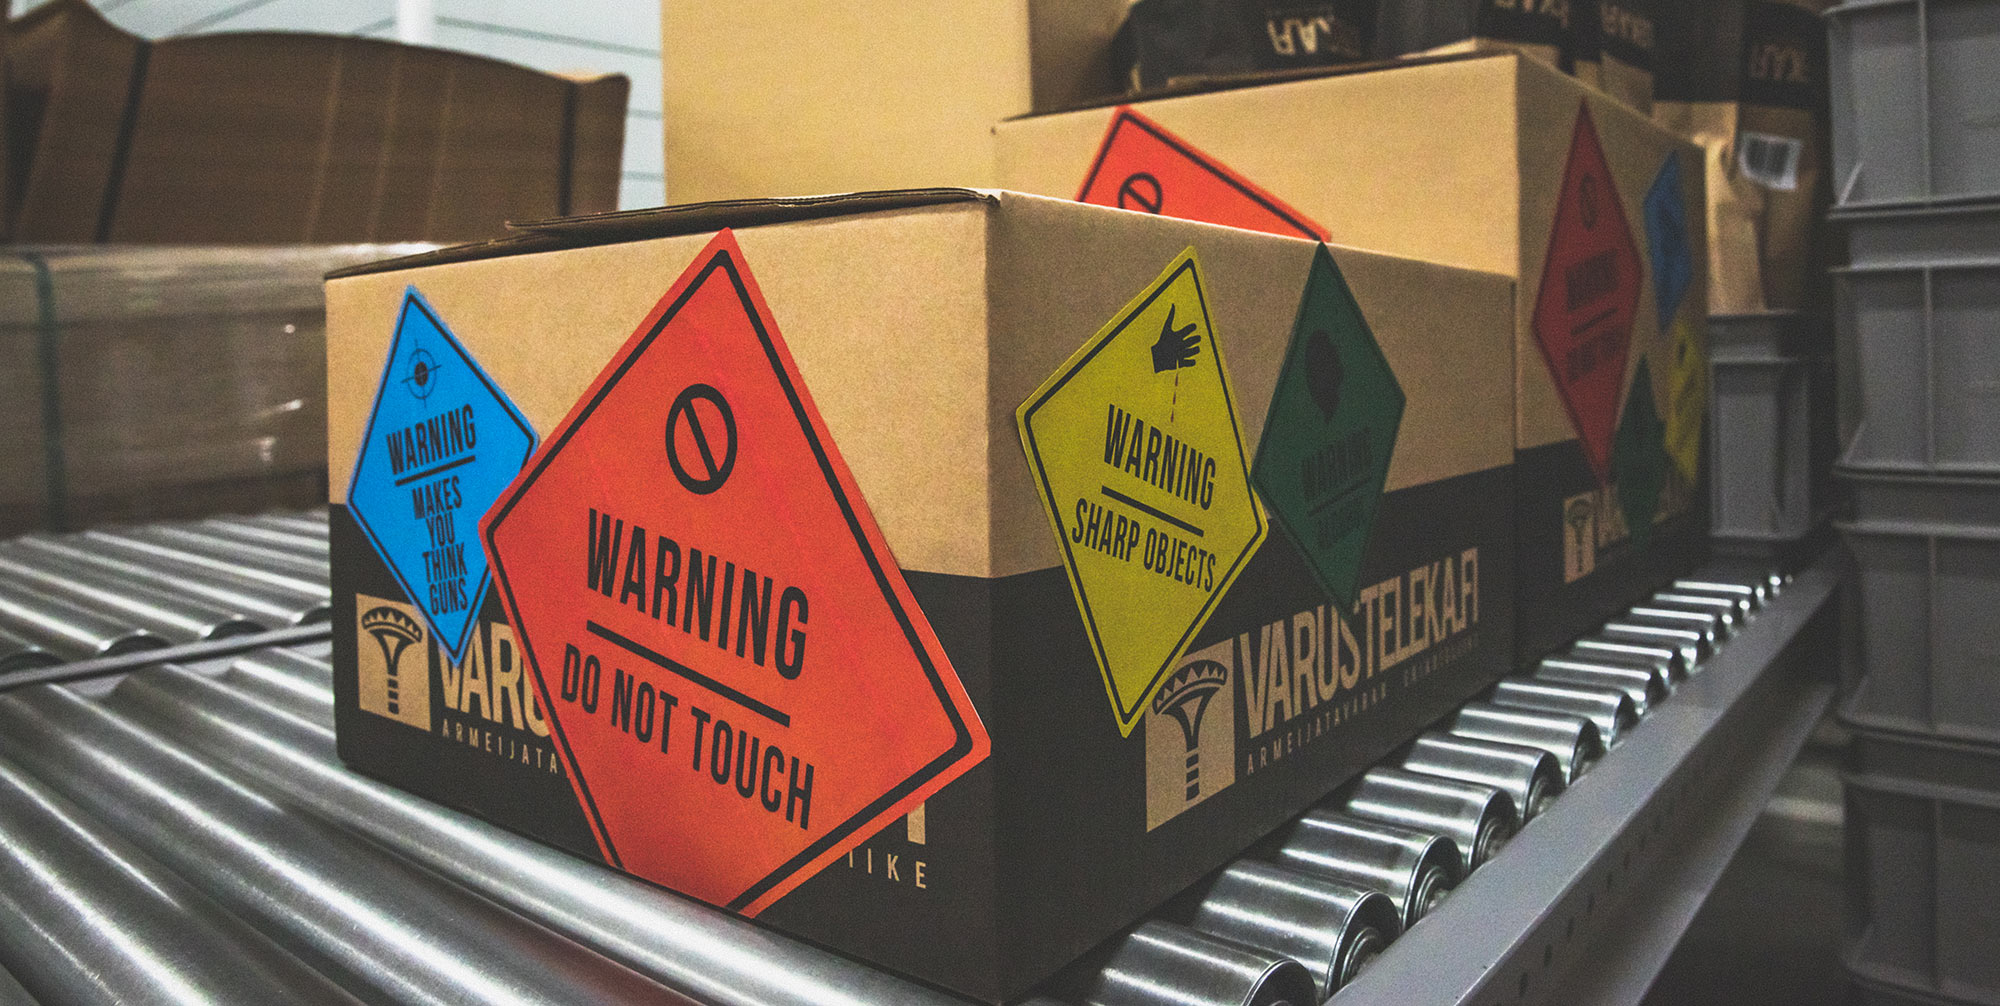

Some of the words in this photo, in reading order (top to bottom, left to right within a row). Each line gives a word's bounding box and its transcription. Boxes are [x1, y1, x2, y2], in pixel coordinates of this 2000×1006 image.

[386, 404, 476, 475] WARNING
[1104, 403, 1216, 511] WARNING
[412, 475, 462, 520] MAKES
[426, 511, 455, 548] YOU
[422, 542, 467, 583] THINK
[1072, 498, 1140, 562] SHARP
[1143, 528, 1216, 592] OBJECTS
[429, 577, 468, 616] GUNS
[587, 507, 809, 680] WARNING
[561, 643, 598, 715] DO
[611, 669, 678, 754] NOT
[691, 704, 815, 830] TOUCH
